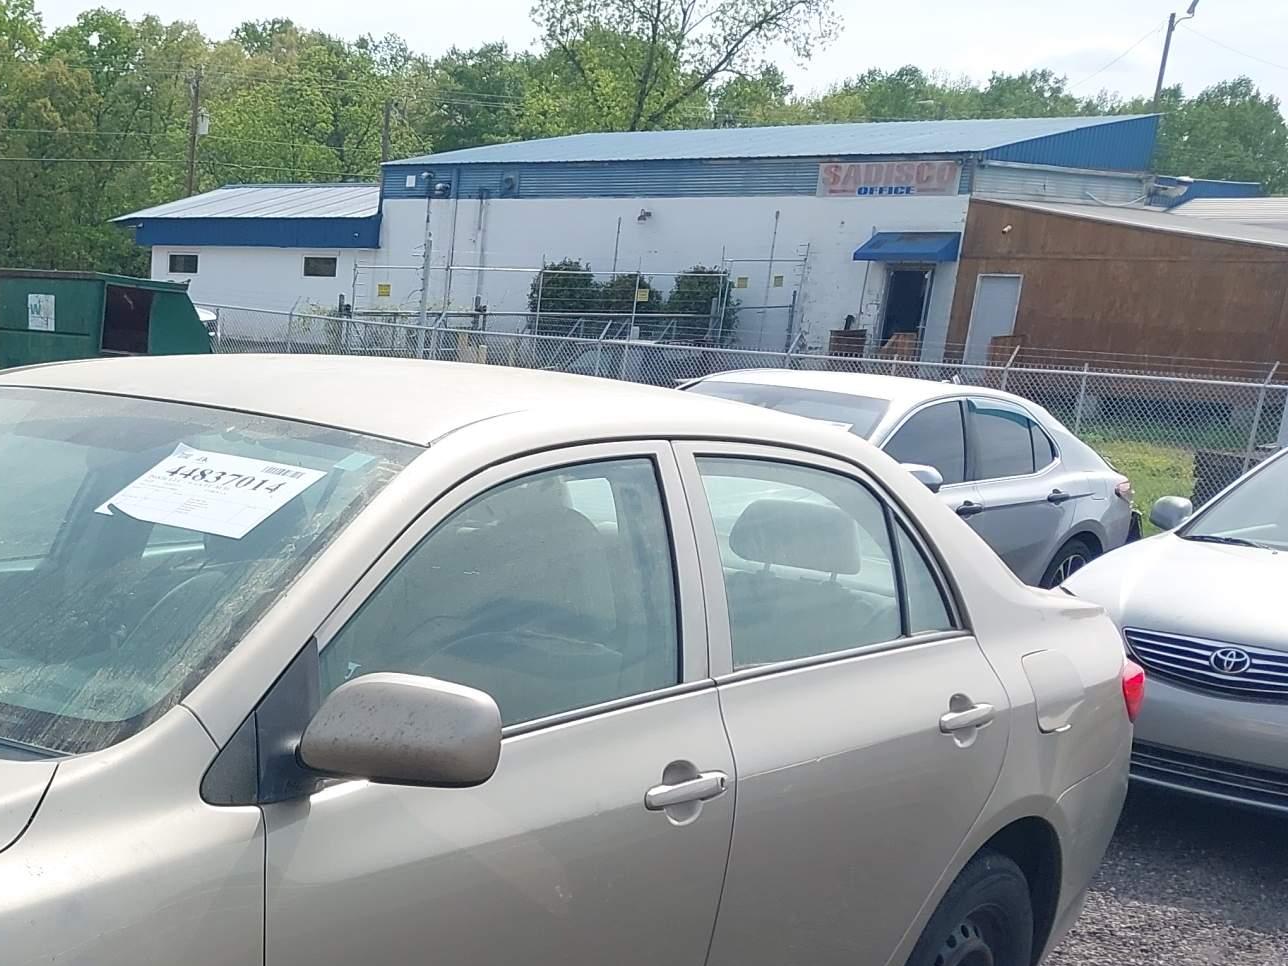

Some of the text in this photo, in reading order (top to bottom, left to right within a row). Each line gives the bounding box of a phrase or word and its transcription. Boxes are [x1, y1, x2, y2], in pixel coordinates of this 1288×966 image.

[823, 164, 959, 186] SADISCO
[857, 186, 915, 196] OFFICE
[165, 465, 287, 494] 44837014
